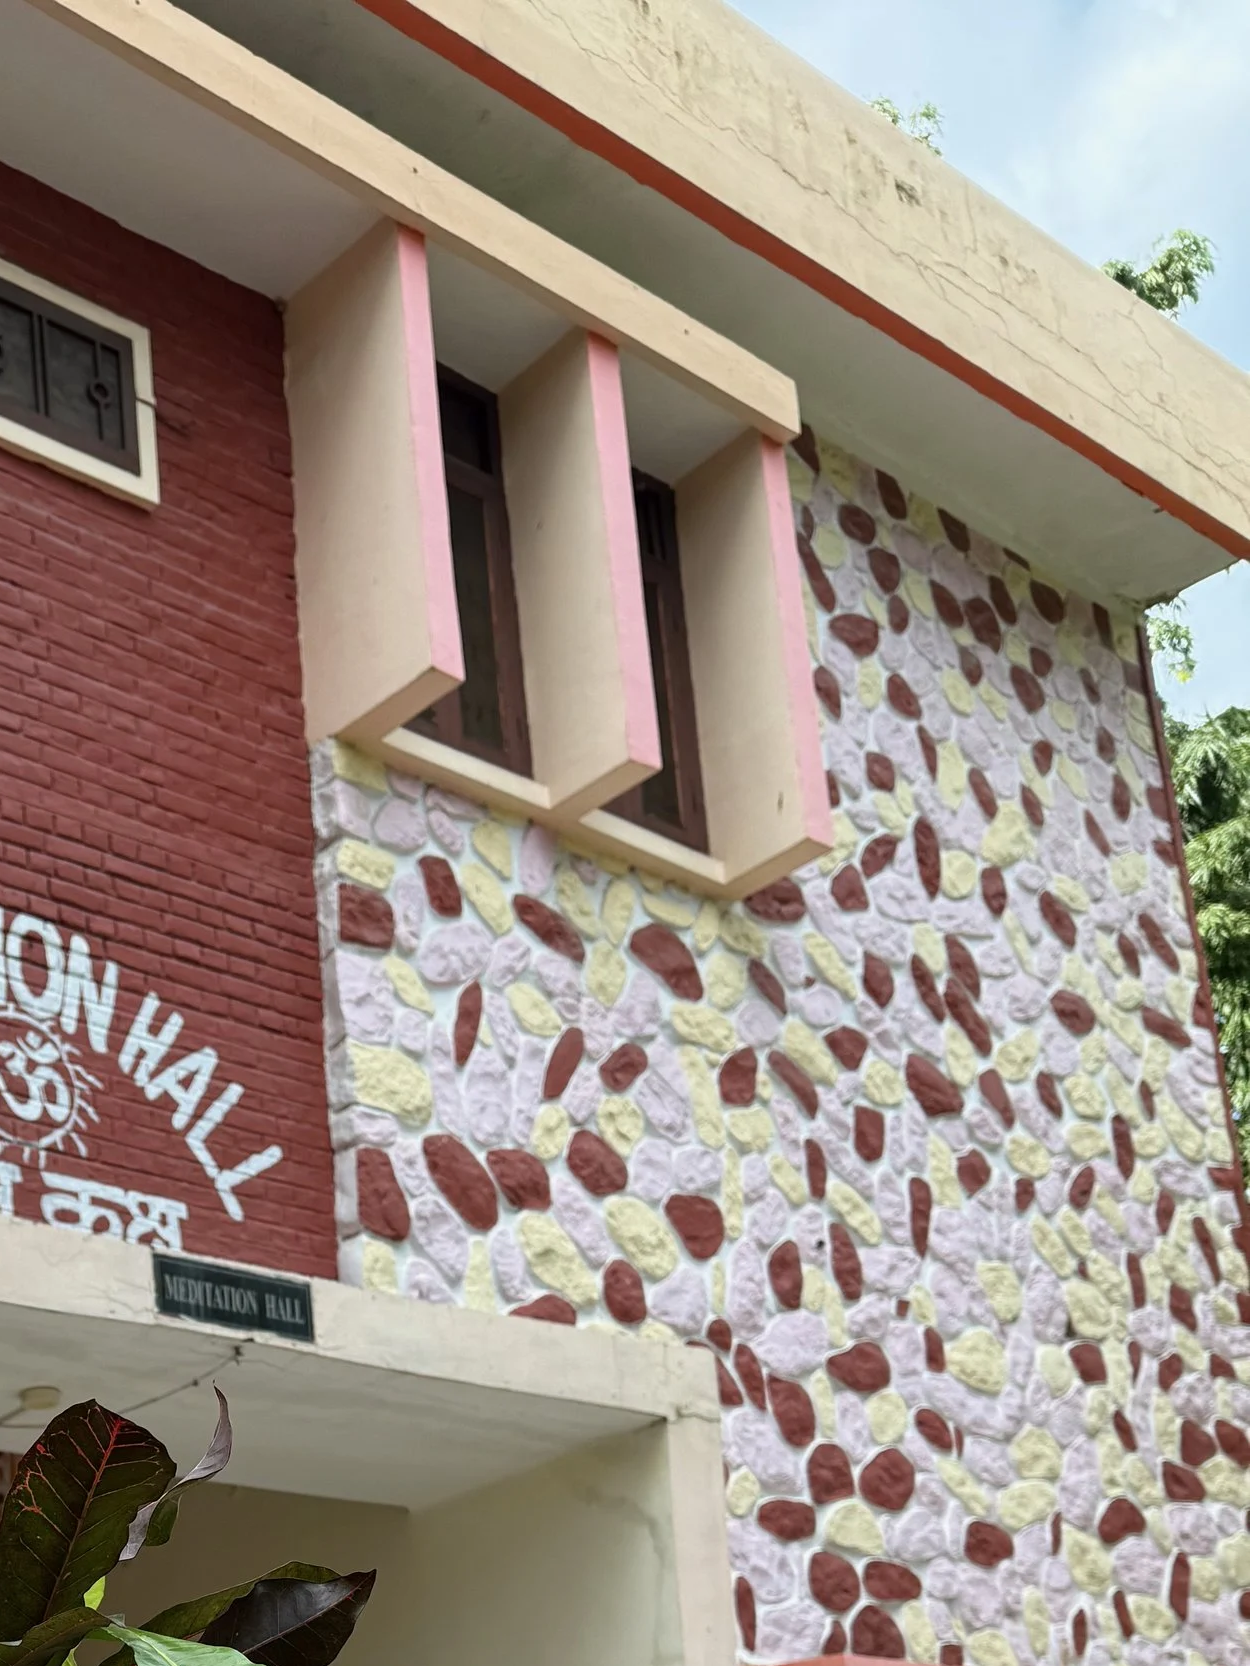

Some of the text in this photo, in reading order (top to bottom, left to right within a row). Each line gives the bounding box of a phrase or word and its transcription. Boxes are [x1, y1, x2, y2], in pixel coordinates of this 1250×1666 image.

[118, 991, 284, 1223] HALL
[163, 1273, 306, 1325] MEDITATION HALL
